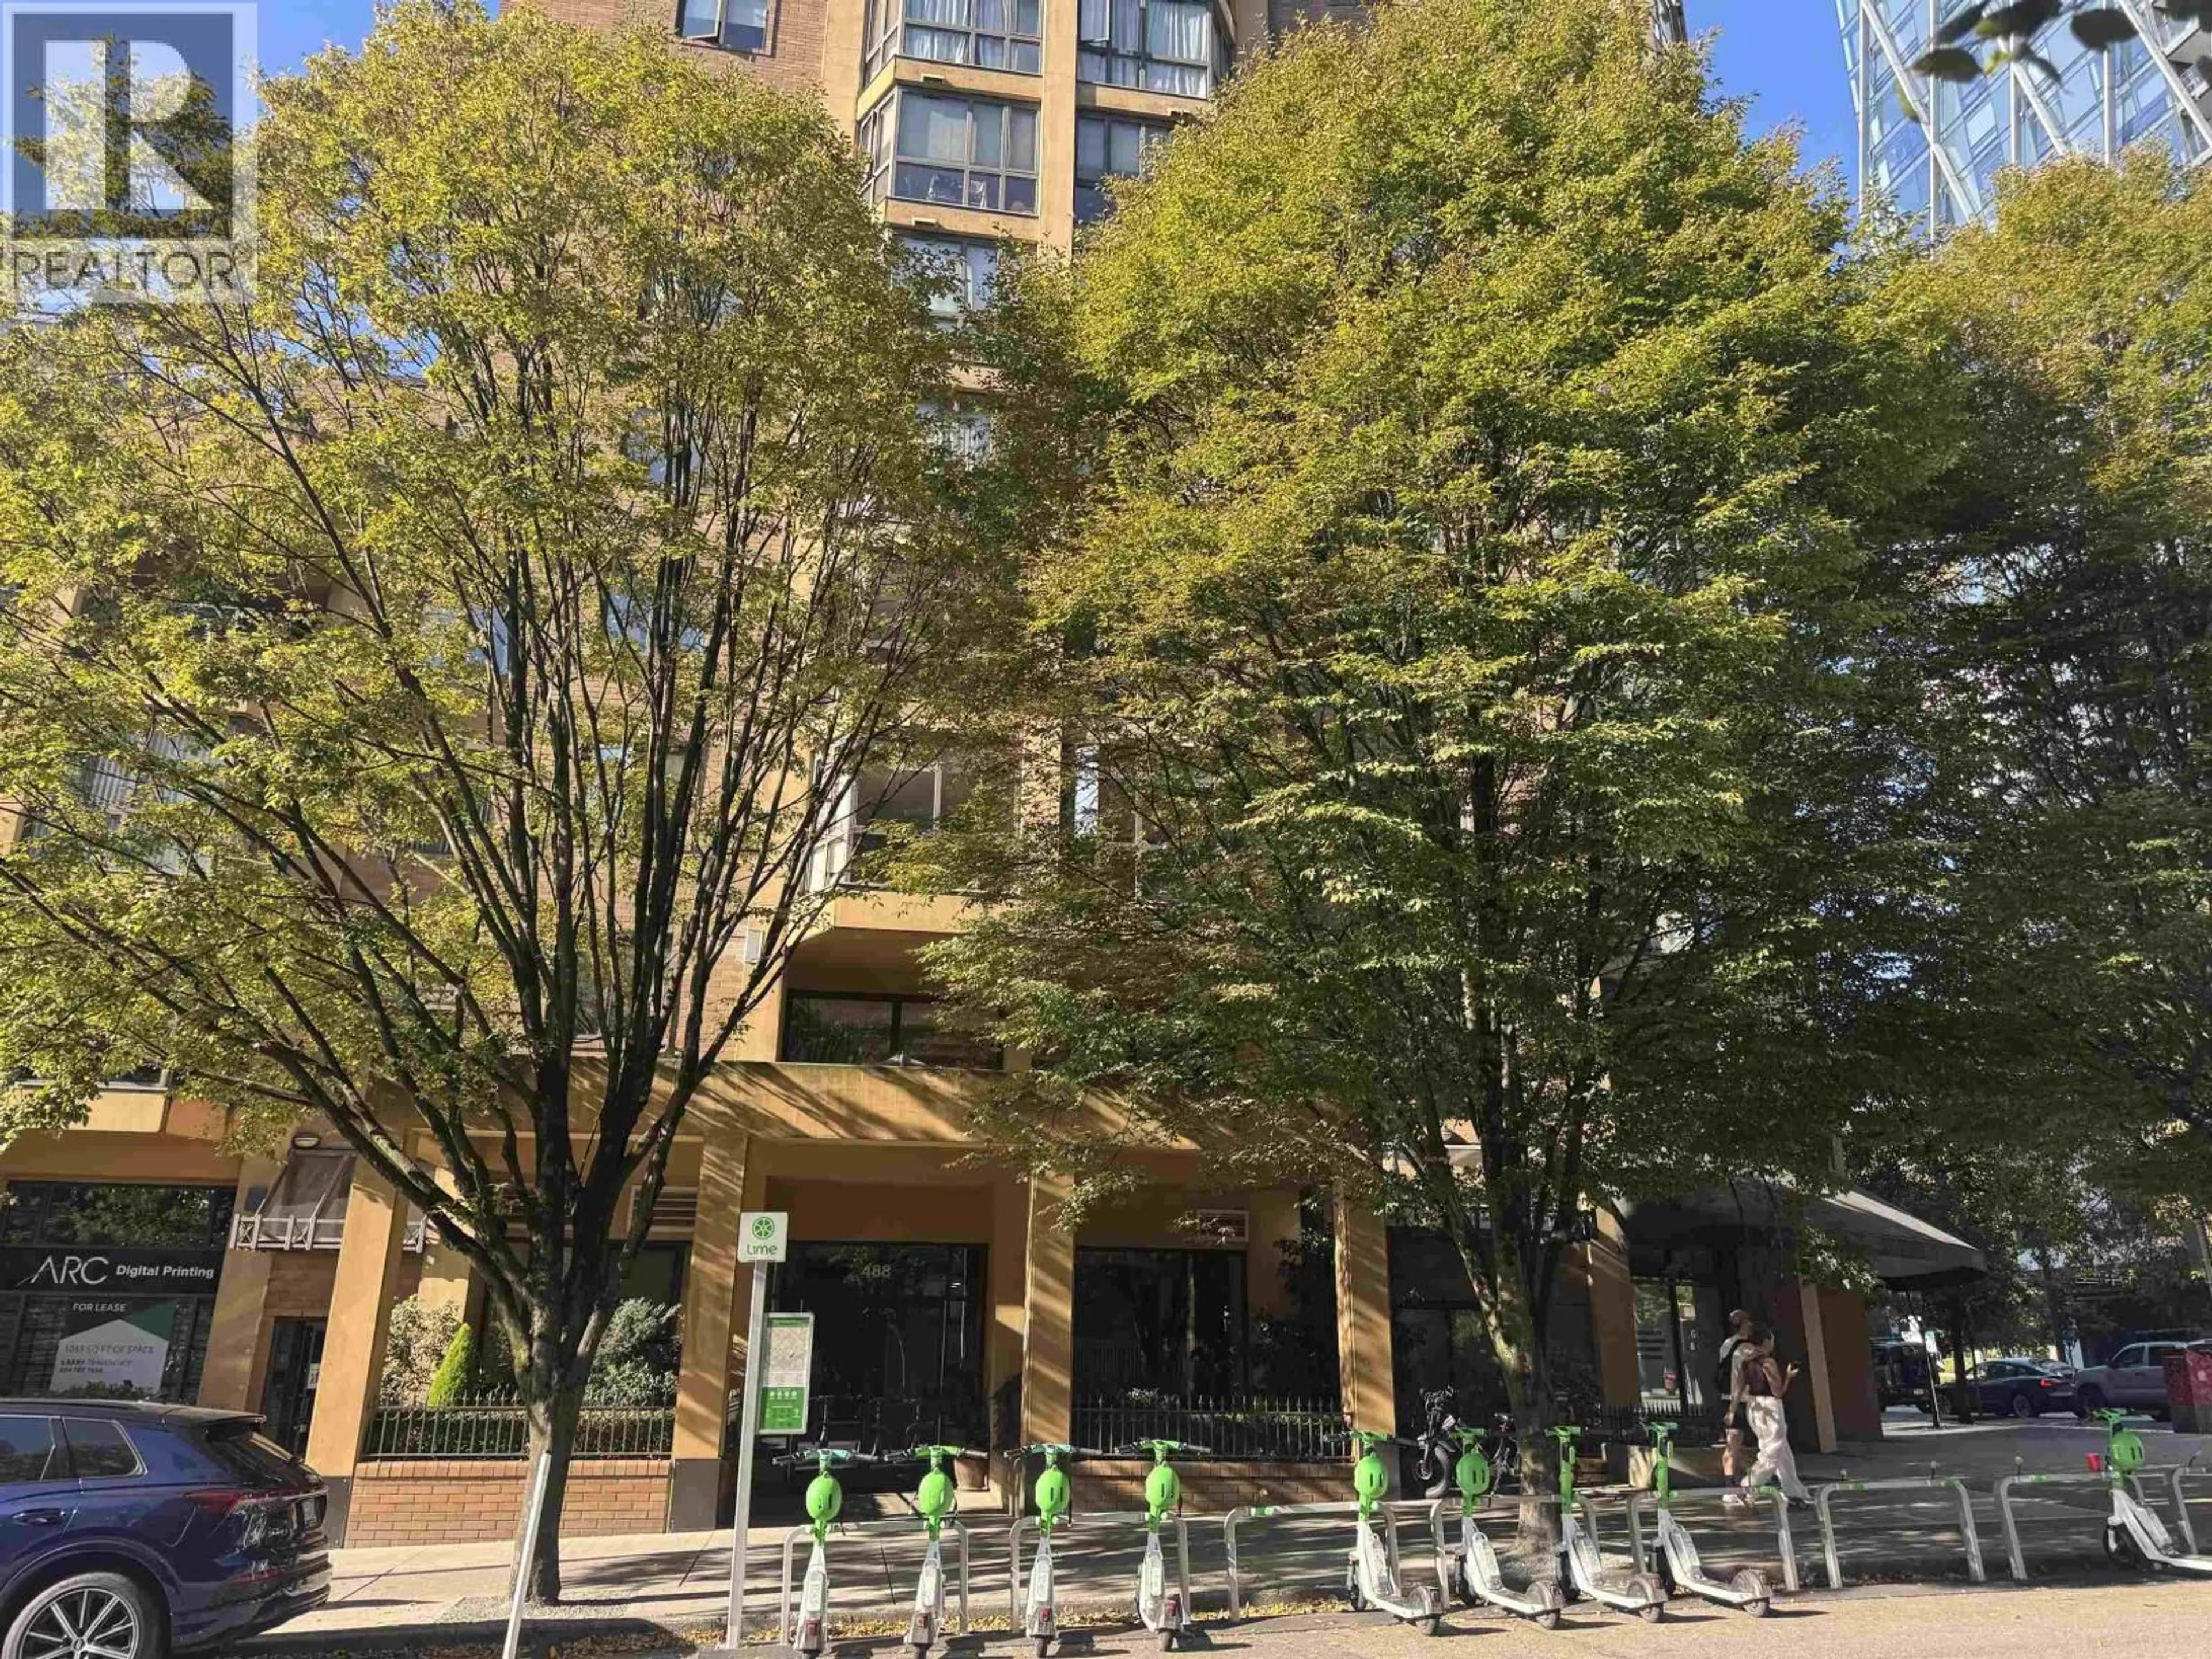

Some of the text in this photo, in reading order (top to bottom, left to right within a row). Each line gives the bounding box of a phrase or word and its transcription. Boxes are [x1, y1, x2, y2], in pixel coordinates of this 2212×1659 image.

[747, 1244, 777, 1255] Lime
[29, 1255, 214, 1285] ARC Digital Printing
[861, 1265, 891, 1278] 488
[73, 1303, 126, 1312] FOR LEASE
